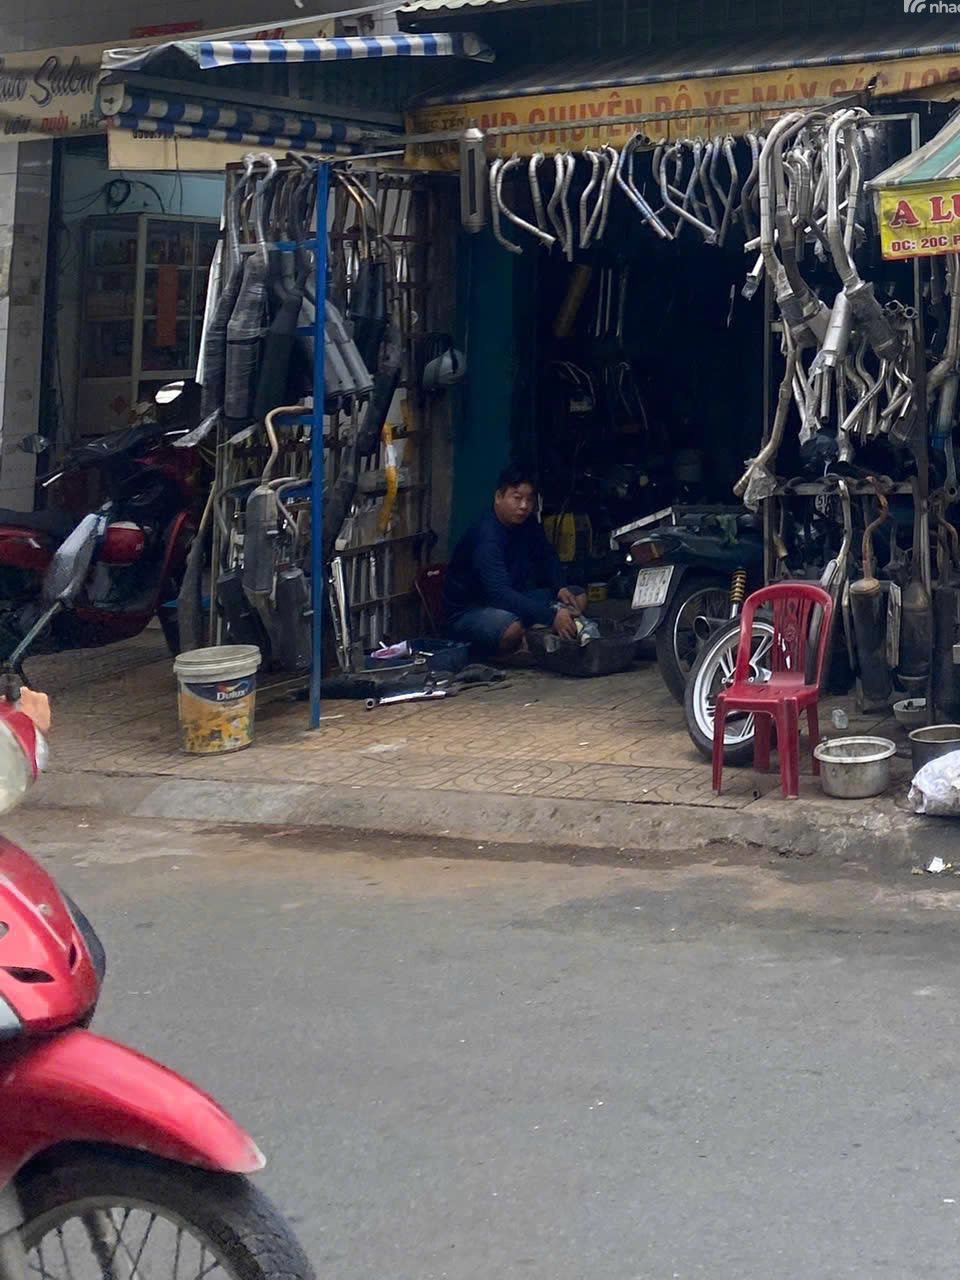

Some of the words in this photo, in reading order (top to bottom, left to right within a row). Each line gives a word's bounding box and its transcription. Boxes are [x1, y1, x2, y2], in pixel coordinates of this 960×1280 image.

[528, 91, 643, 146] CHUYÊN
[704, 88, 739, 130] XE
[890, 198, 919, 227] A
[921, 236, 949, 250] 20C
[216, 688, 249, 701] Dulux
